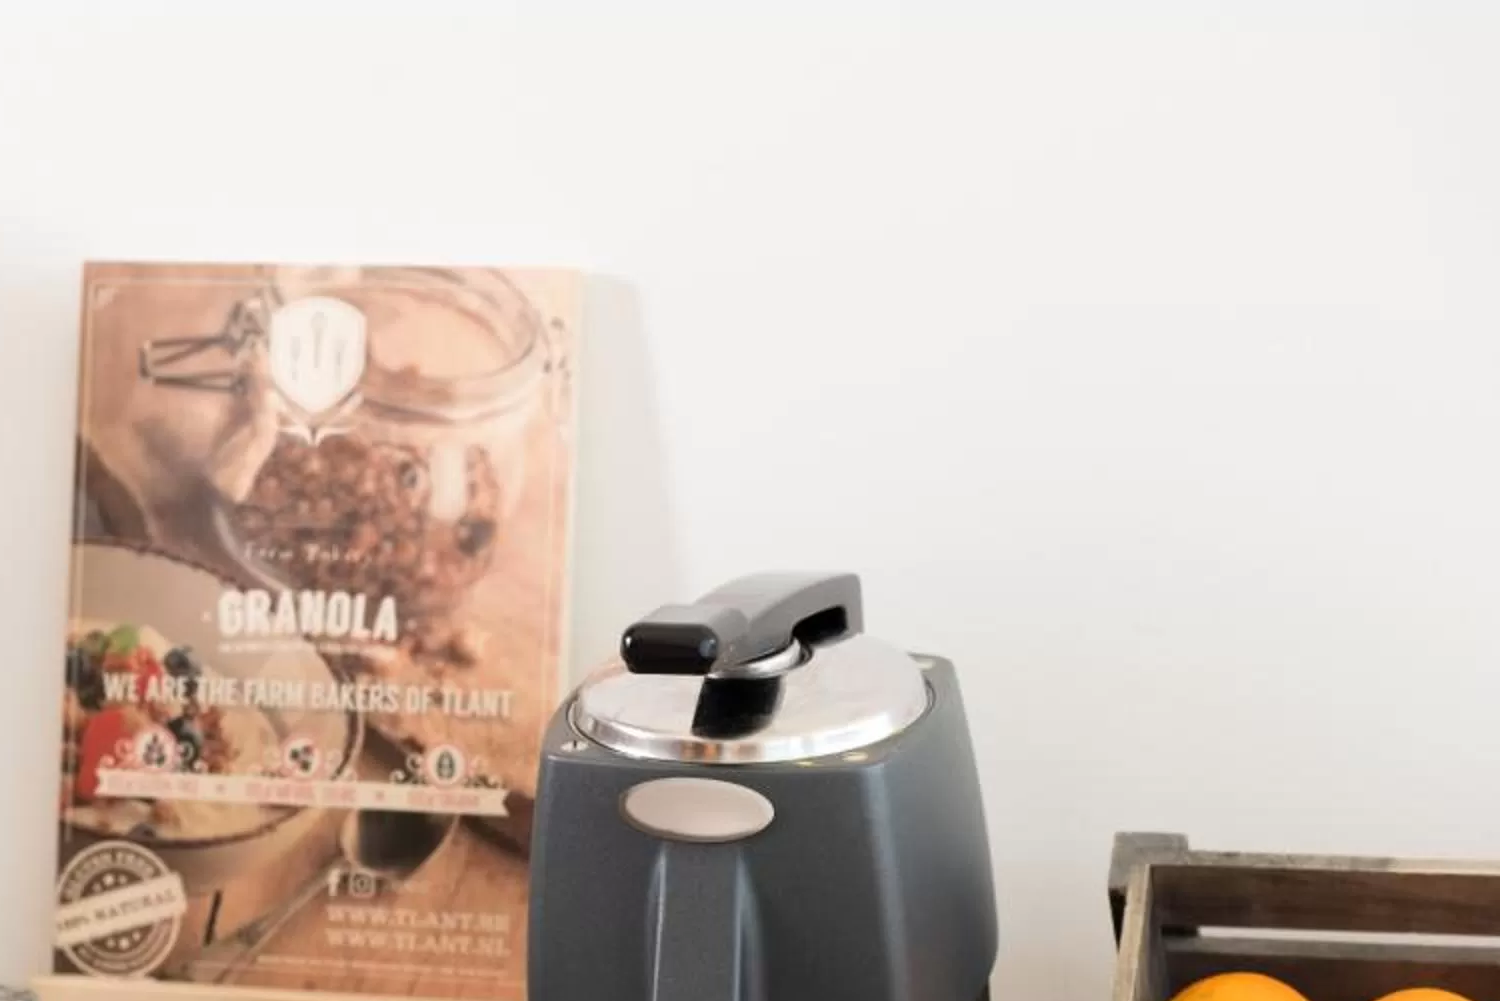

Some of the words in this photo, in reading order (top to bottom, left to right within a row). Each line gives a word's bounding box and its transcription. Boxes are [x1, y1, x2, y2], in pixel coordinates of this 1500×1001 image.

[218, 588, 398, 641] GRANOLA
[102, 671, 139, 702] WE
[146, 674, 189, 704] ARE
[197, 676, 237, 707] THE
[243, 678, 303, 710] FARM
[311, 681, 399, 714] BAKERS
[406, 685, 434, 715] OF
[441, 687, 514, 719] TLANT
